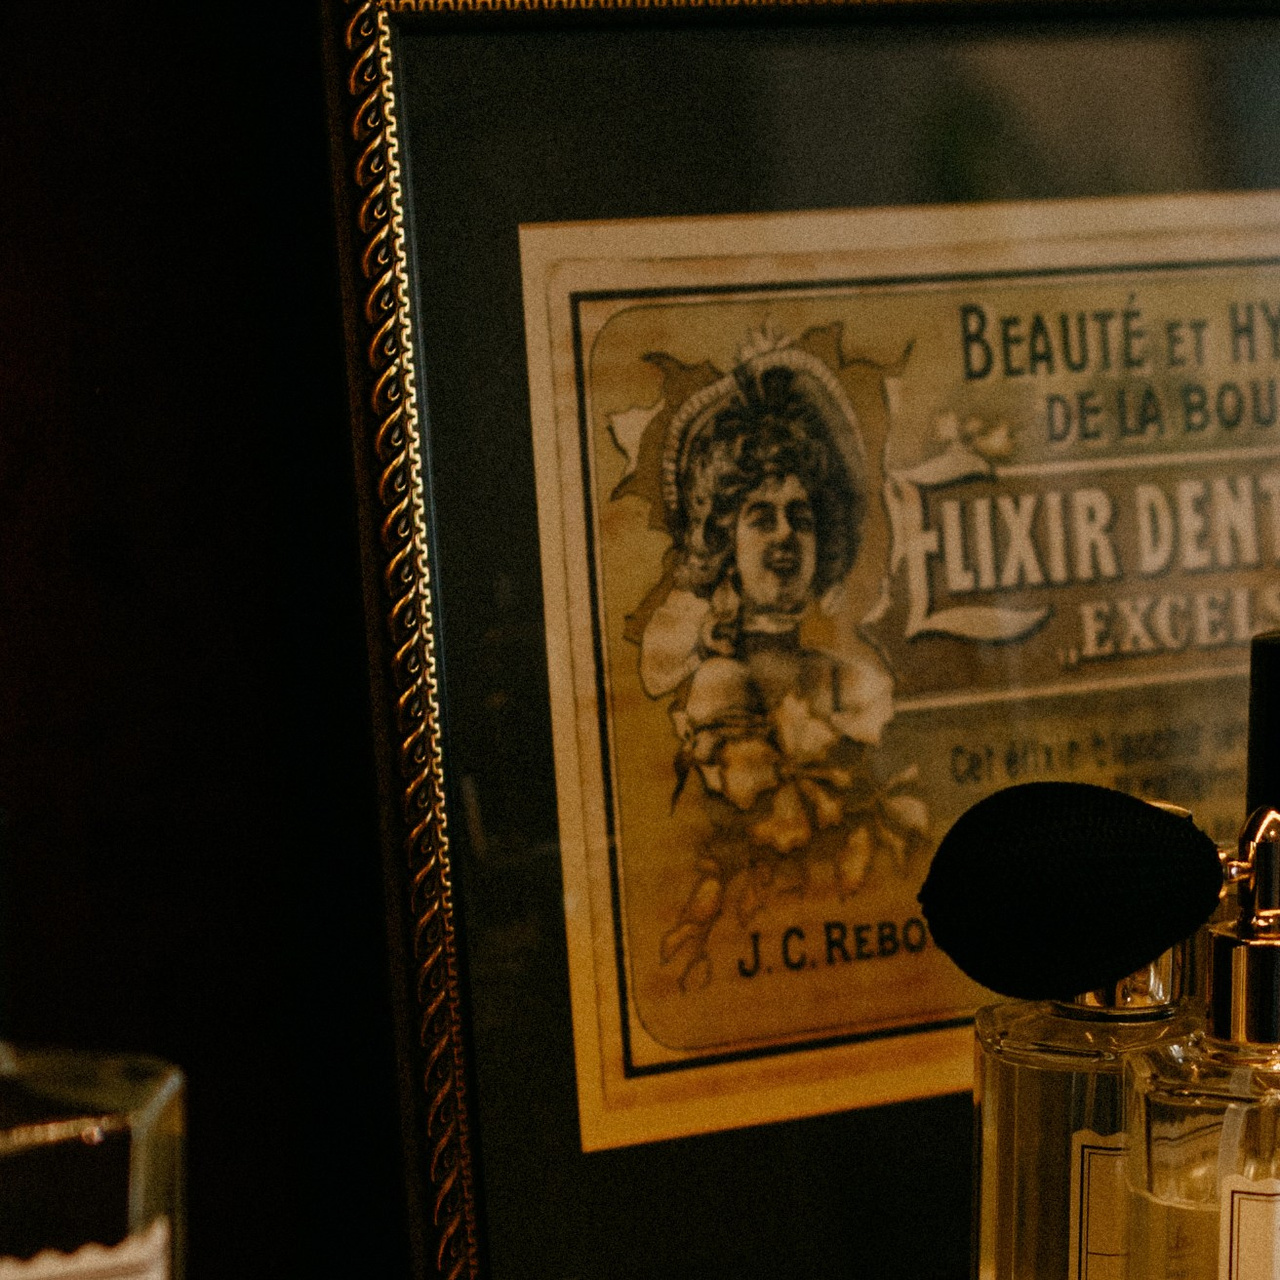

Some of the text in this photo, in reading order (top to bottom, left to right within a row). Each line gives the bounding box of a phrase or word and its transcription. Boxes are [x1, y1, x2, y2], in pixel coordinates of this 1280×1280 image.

[960, 293, 1143, 381] BEAUTÉ
[1169, 320, 1208, 369] ET
[1046, 390, 1104, 444] DE
[1113, 383, 1164, 438] LA
[886, 460, 1122, 642] ELIXIR
